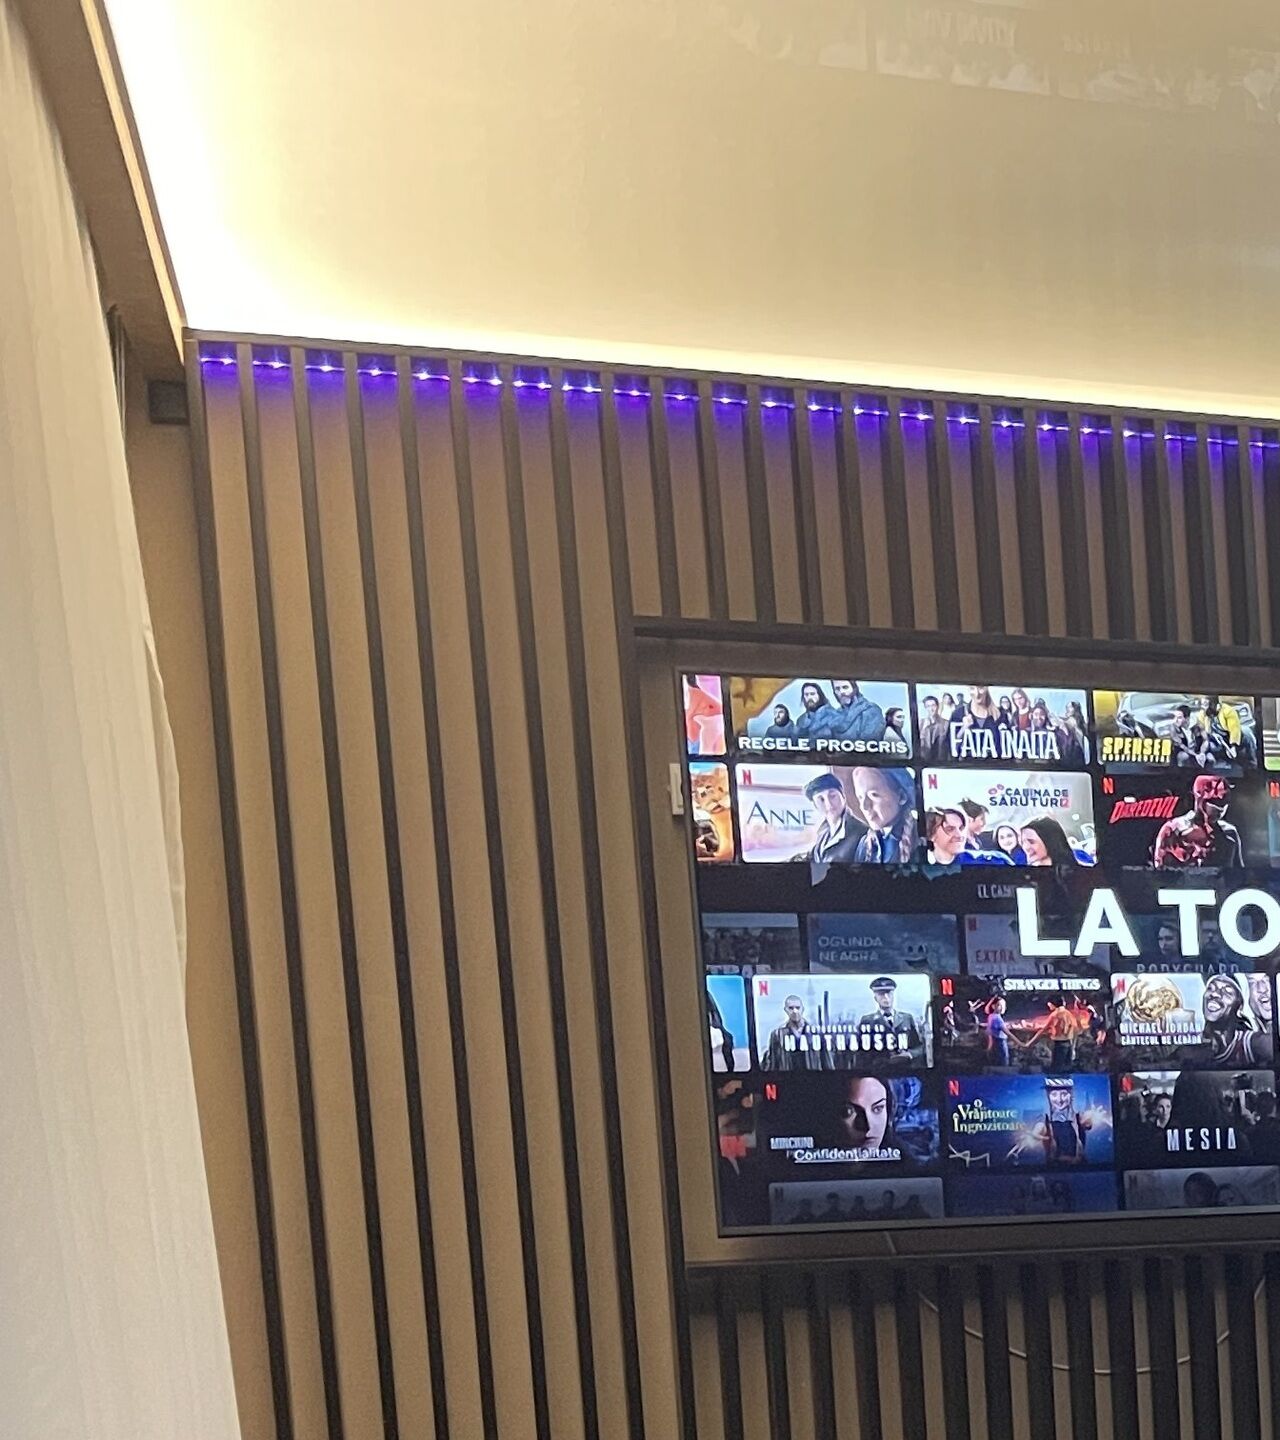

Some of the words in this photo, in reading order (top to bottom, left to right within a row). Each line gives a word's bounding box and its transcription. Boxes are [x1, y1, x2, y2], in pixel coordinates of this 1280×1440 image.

[738, 736, 811, 751] REGELE
[816, 738, 909, 754] PROSCRIS
[949, 721, 998, 758] FATA
[1102, 737, 1172, 756] SPENSER
[746, 800, 815, 826] ANNE
[1015, 887, 1141, 957] LA
[818, 935, 884, 948] OGLINDA
[1003, 978, 1060, 991] STRANGER
[1060, 978, 1101, 991] THINGS
[1119, 1022, 1163, 1035] MICHAEL
[1166, 1127, 1237, 1151] MESIA
